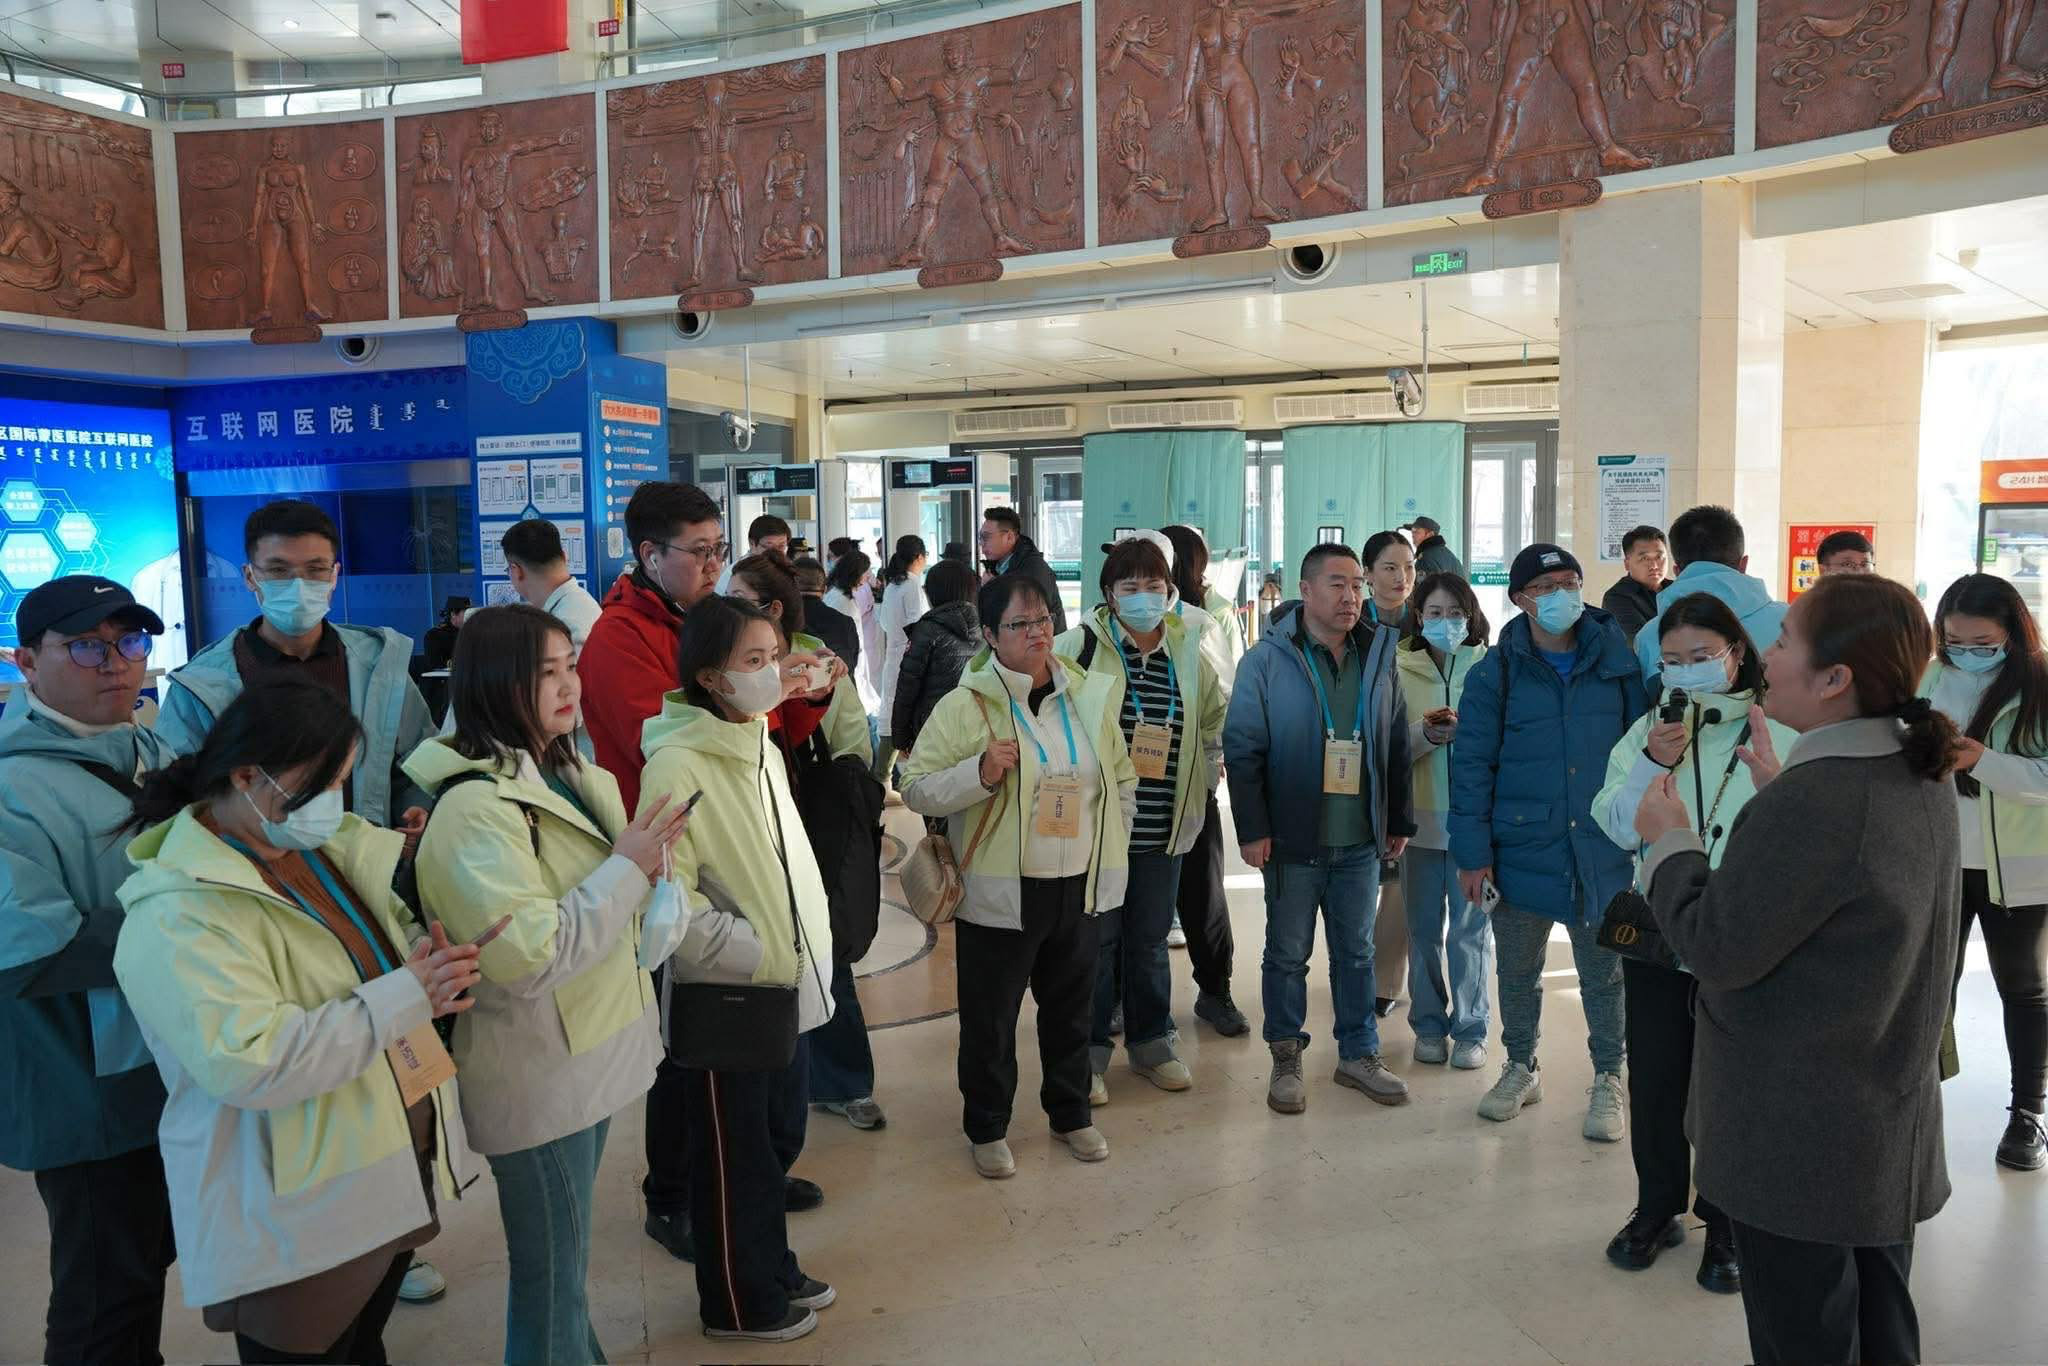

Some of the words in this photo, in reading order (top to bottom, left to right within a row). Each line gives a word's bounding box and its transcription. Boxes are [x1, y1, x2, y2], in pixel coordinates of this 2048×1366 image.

[1447, 260, 1463, 269] EXIT
[186, 405, 354, 442] 互联网医院
